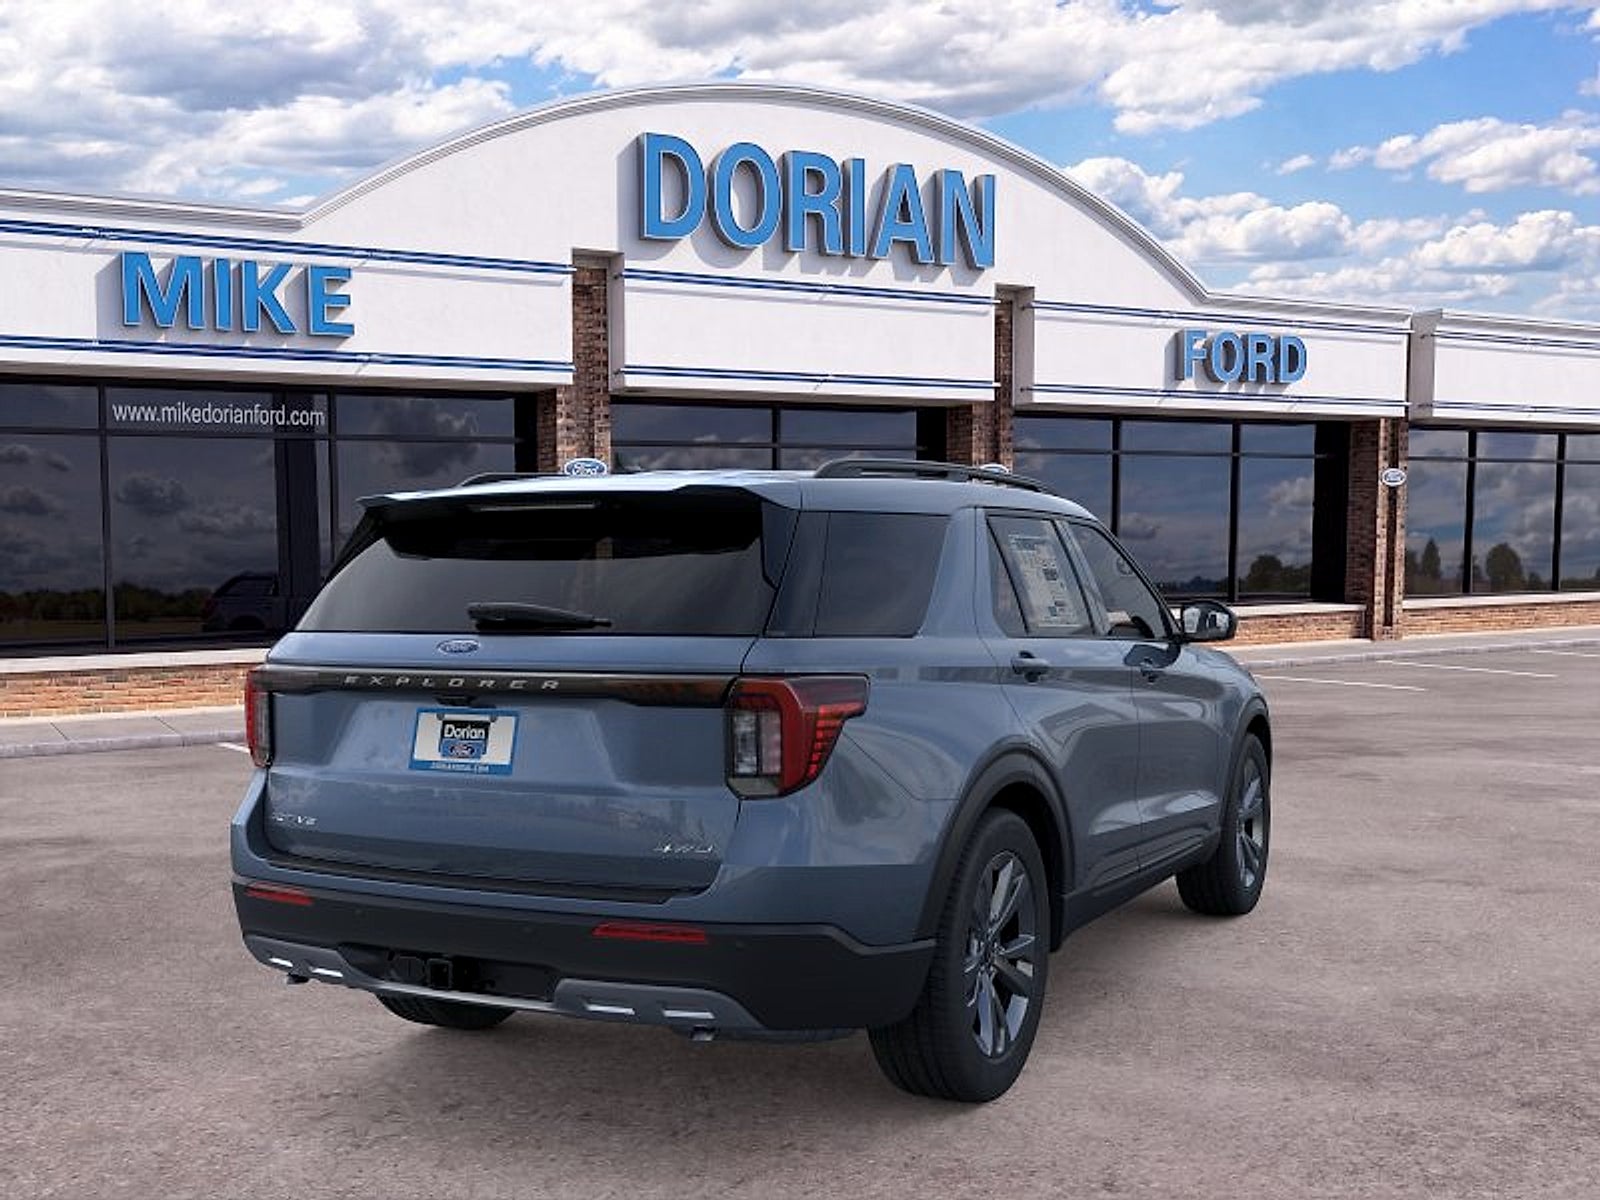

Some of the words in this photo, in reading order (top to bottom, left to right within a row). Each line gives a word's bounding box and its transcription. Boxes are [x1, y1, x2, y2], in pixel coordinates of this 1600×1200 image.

[639, 132, 996, 270] DORIAN
[120, 251, 355, 337] MIKE
[1178, 329, 1308, 384] FORD
[112, 402, 326, 426] www.mikedorianford.com
[343, 674, 561, 690] EXPLORER
[443, 723, 486, 740] Dorian
